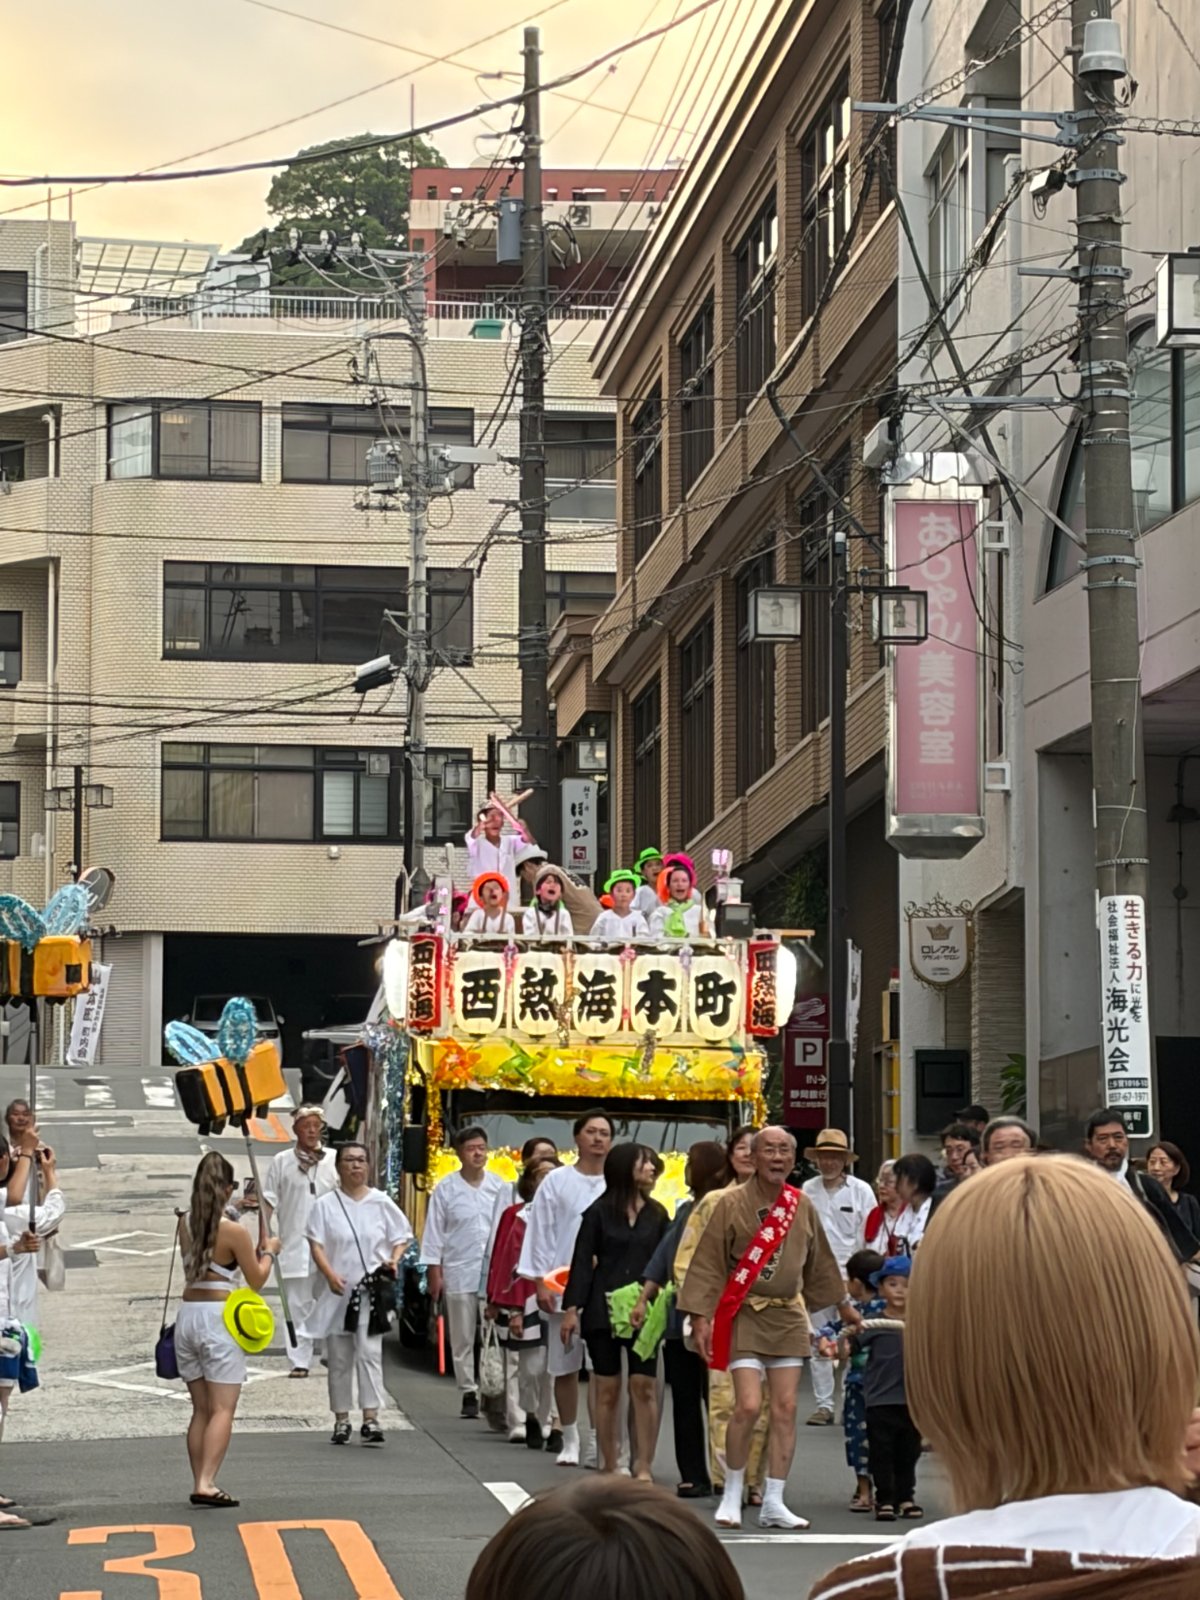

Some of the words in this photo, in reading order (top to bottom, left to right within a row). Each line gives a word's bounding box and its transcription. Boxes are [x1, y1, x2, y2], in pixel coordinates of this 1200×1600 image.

[571, 802, 589, 840] ほのか
[921, 945, 960, 954] ロレアル
[1107, 901, 1121, 984] 社会福祉法人
[461, 966, 738, 1028] 西熱海本町
[802, 1042, 817, 1062] P
[1106, 987, 1130, 1073] 海光会
[806, 1075, 818, 1084] IN
[60, 1519, 405, 1600] 30
